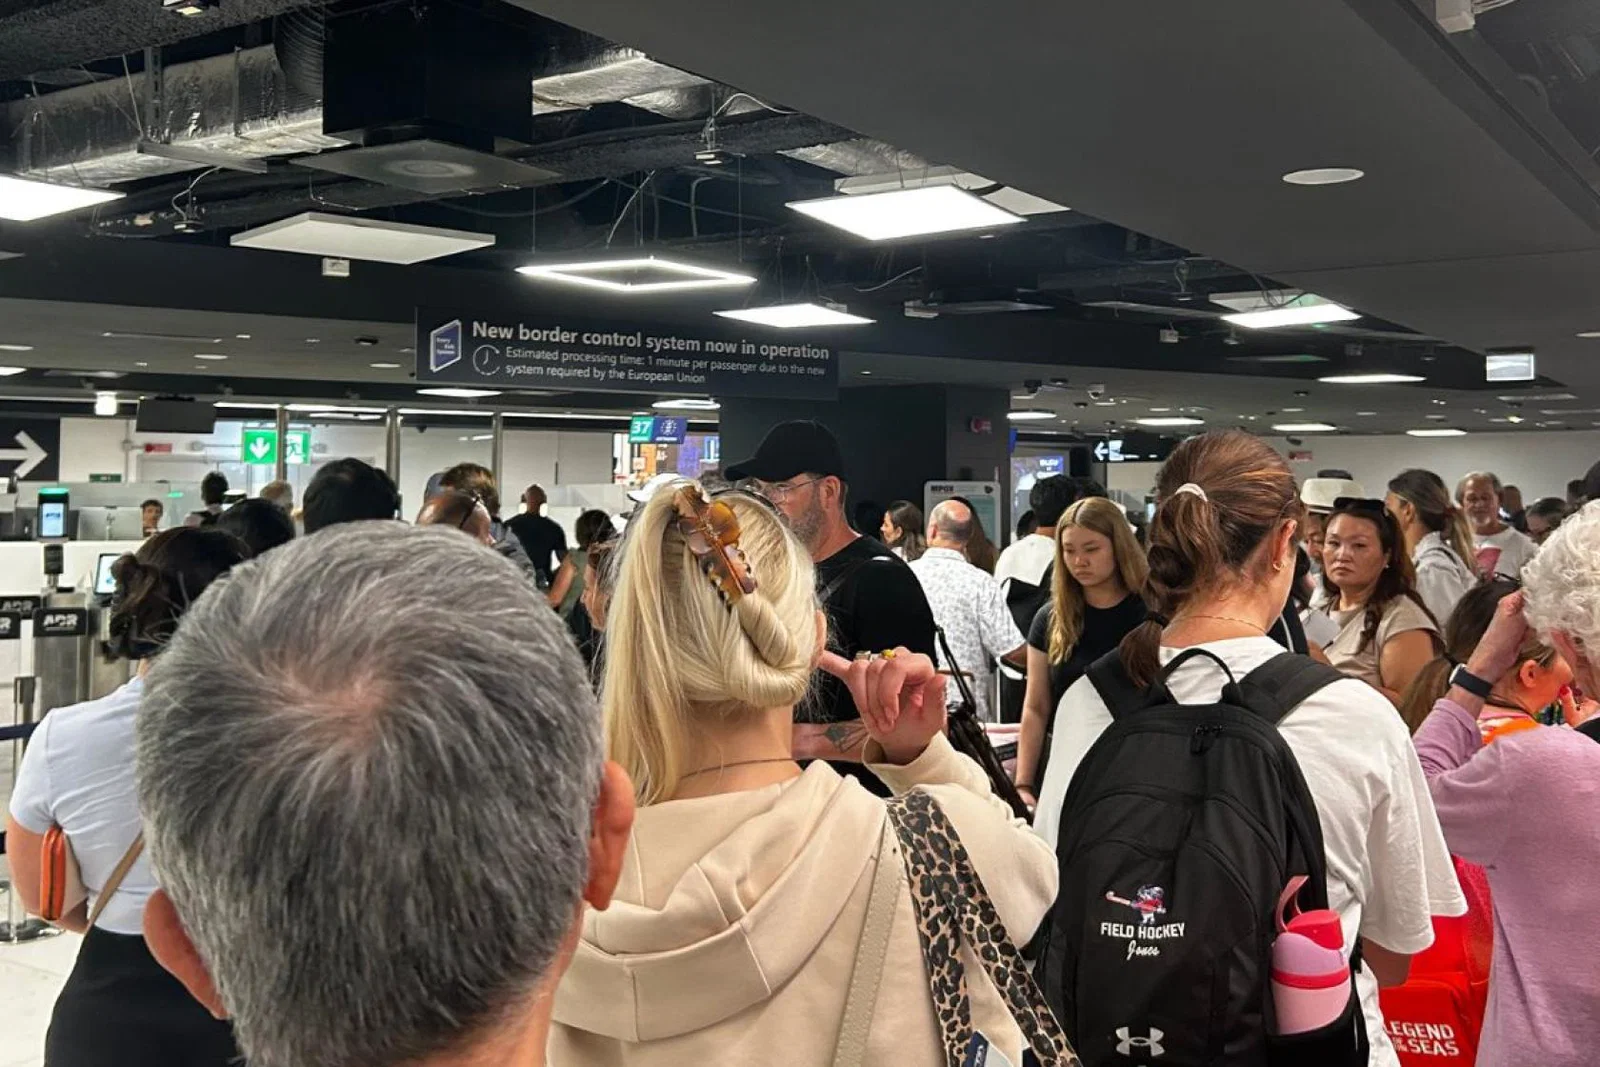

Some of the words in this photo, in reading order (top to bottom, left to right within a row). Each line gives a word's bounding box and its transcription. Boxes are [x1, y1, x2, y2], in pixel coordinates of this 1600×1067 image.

[472, 321, 514, 340] New
[519, 323, 579, 345] border
[582, 332, 642, 348] control
[645, 336, 701, 352] system
[705, 340, 738, 354] now
[741, 339, 756, 355] in
[760, 344, 830, 360] operation
[506, 346, 560, 360] Estimated
[562, 352, 617, 367] processing
[619, 353, 645, 365] time:
[647, 355, 654, 365] 1
[655, 356, 690, 368] minute
[692, 360, 709, 371] per
[710, 361, 758, 374] passenger
[758, 362, 777, 373] due
[779, 364, 789, 374] to
[790, 364, 805, 375] the
[806, 367, 826, 376] new
[505, 365, 544, 377] system
[546, 367, 591, 379] required
[593, 367, 606, 380] by
[608, 368, 626, 380] the
[628, 369, 674, 384] European
[676, 372, 705, 383] Union
[631, 422, 651, 435] 37
[1100, 922, 1135, 938] FIELD
[1138, 922, 1186, 940] HOCKEY
[1383, 1020, 1455, 1040] LEGEND
[1407, 1037, 1460, 1057] SEAS
